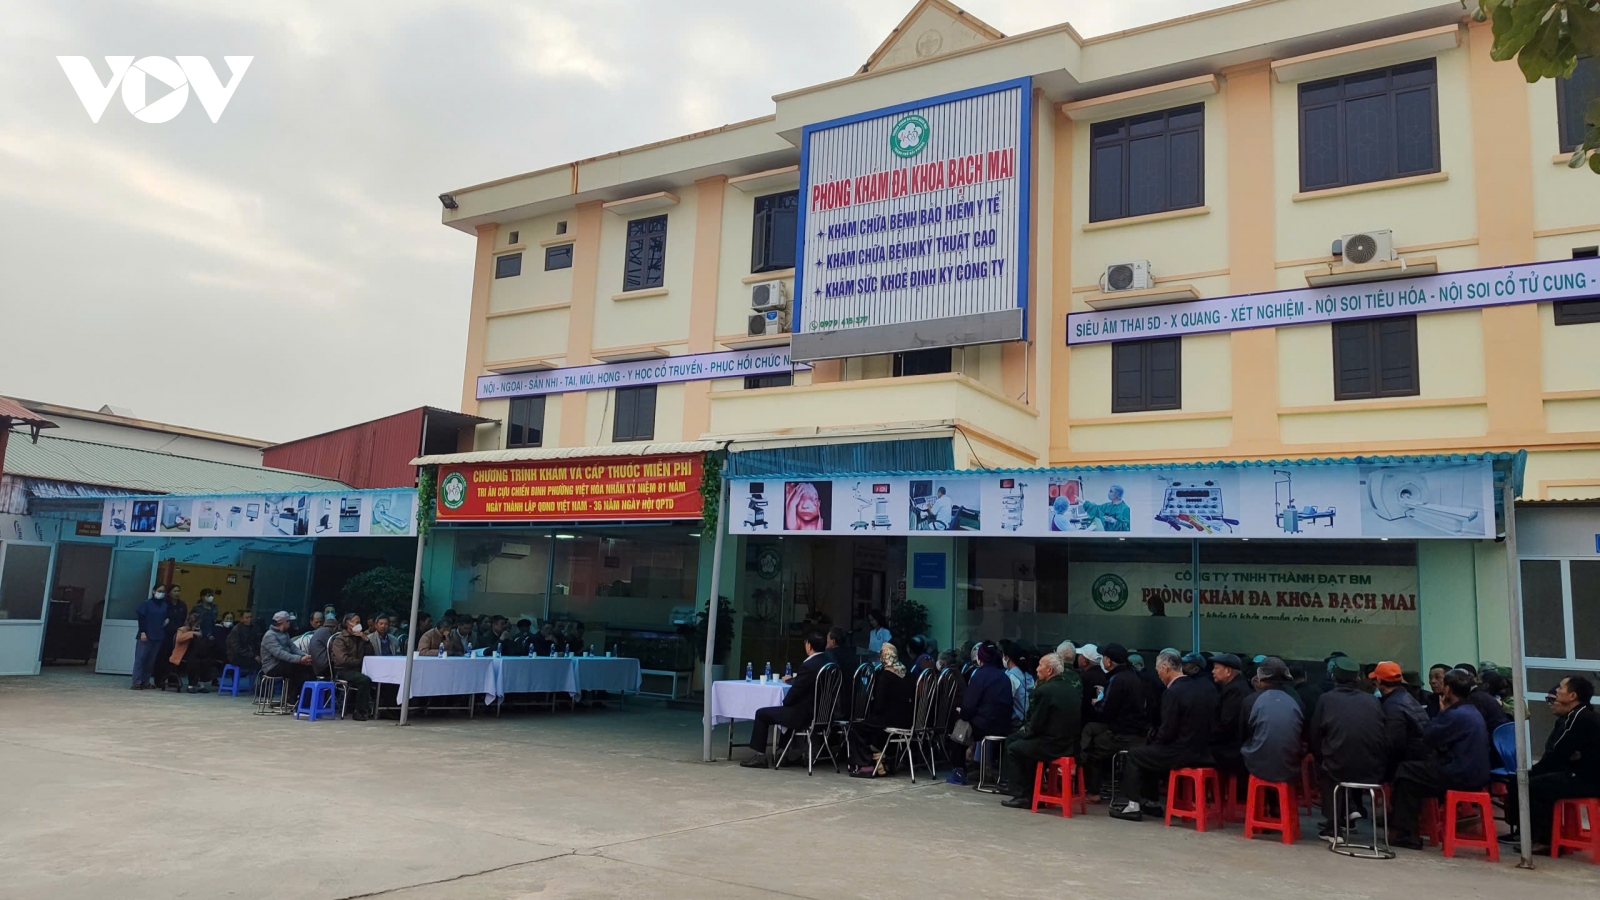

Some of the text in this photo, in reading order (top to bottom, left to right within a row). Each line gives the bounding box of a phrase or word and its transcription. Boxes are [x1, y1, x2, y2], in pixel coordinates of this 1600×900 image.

[812, 148, 1014, 212] PHÒNG KHÁM ĐA KHOA BẠCH MAI
[828, 192, 1001, 240] KHÁM CHỮA BỆNH BẢO HIỂM Y TẾ
[826, 229, 995, 270] KHÁM CHỮA BỆNH KỸ THUẬT CAO
[826, 278, 854, 298] KHÁM
[858, 274, 877, 294] SỨC
[910, 268, 936, 291] ĐỊNH
[940, 263, 953, 283] KỲ
[956, 260, 987, 280] CÔNG
[992, 259, 1004, 276] TY
[1076, 320, 1099, 337] SIÊU
[1102, 318, 1117, 334] ÂM
[1120, 317, 1144, 333] THAI
[1147, 316, 1161, 330] 5D
[1171, 314, 1177, 328] X
[1181, 309, 1221, 327] QUANG
[1231, 303, 1253, 322] XÉT
[1257, 299, 1304, 320] NGHIỆM
[1316, 294, 1337, 316] NỘI
[1340, 295, 1361, 311] SOI
[1365, 289, 1394, 309] TIÊU
[1399, 286, 1427, 306] HÓA
[1439, 282, 1462, 304] NỘI
[1467, 282, 1490, 299] SOI
[1495, 270, 1516, 296] CỔ
[1519, 271, 1539, 294] TỬ
[1543, 272, 1586, 292] CUNG
[483, 382, 495, 395] NỘI
[501, 381, 523, 393] NGOẠI
[529, 375, 544, 390] SẢN
[545, 377, 558, 388] NHI
[565, 376, 577, 387] TAI,
[579, 372, 595, 385] MŨI,
[598, 372, 620, 385] HỌNG
[627, 370, 633, 380] Y
[635, 368, 652, 382] HỌC
[654, 361, 666, 378] CỔ
[710, 359, 734, 374] PHỤC
[737, 356, 752, 370] HỒI
[754, 354, 781, 369] CHỨC
[473, 468, 508, 482] CHƯƠNG
[510, 466, 537, 482] TRÌNH
[540, 465, 567, 481] KHÁM
[570, 465, 582, 479] VÀ
[585, 462, 605, 479] CẤP
[608, 460, 640, 478] THUỐC
[643, 459, 670, 477] MIỄN
[674, 459, 692, 476] PHÍ
[478, 488, 487, 497] TRI
[498, 486, 510, 498] CỰU
[511, 484, 529, 496] CHIẾN
[531, 486, 546, 496] BINH
[547, 483, 573, 495] PHƯỜNG
[575, 483, 589, 497] VIỆT
[606, 482, 625, 494] NHÂN
[638, 481, 656, 495] NIỆM
[658, 483, 666, 493] 81
[668, 480, 686, 492] NĂM
[486, 501, 501, 512] NGÀY
[503, 500, 523, 512] THÀNH
[524, 500, 536, 513] LẬP
[557, 499, 570, 513] VIỆT
[572, 501, 587, 511] NAM
[594, 501, 602, 510] 36
[604, 498, 620, 510] NĂM
[622, 498, 640, 510] NGÀY
[642, 497, 654, 512] HỘI
[1174, 570, 1372, 586] CÔG TY TNHH THÀNH ĐẠT BM
[1199, 585, 1244, 605] KHÁM
[1249, 590, 1272, 606] ĐA
[1276, 591, 1324, 608] KHOA
[1328, 593, 1377, 613] BẠCH
[1381, 594, 1417, 610] MAI
